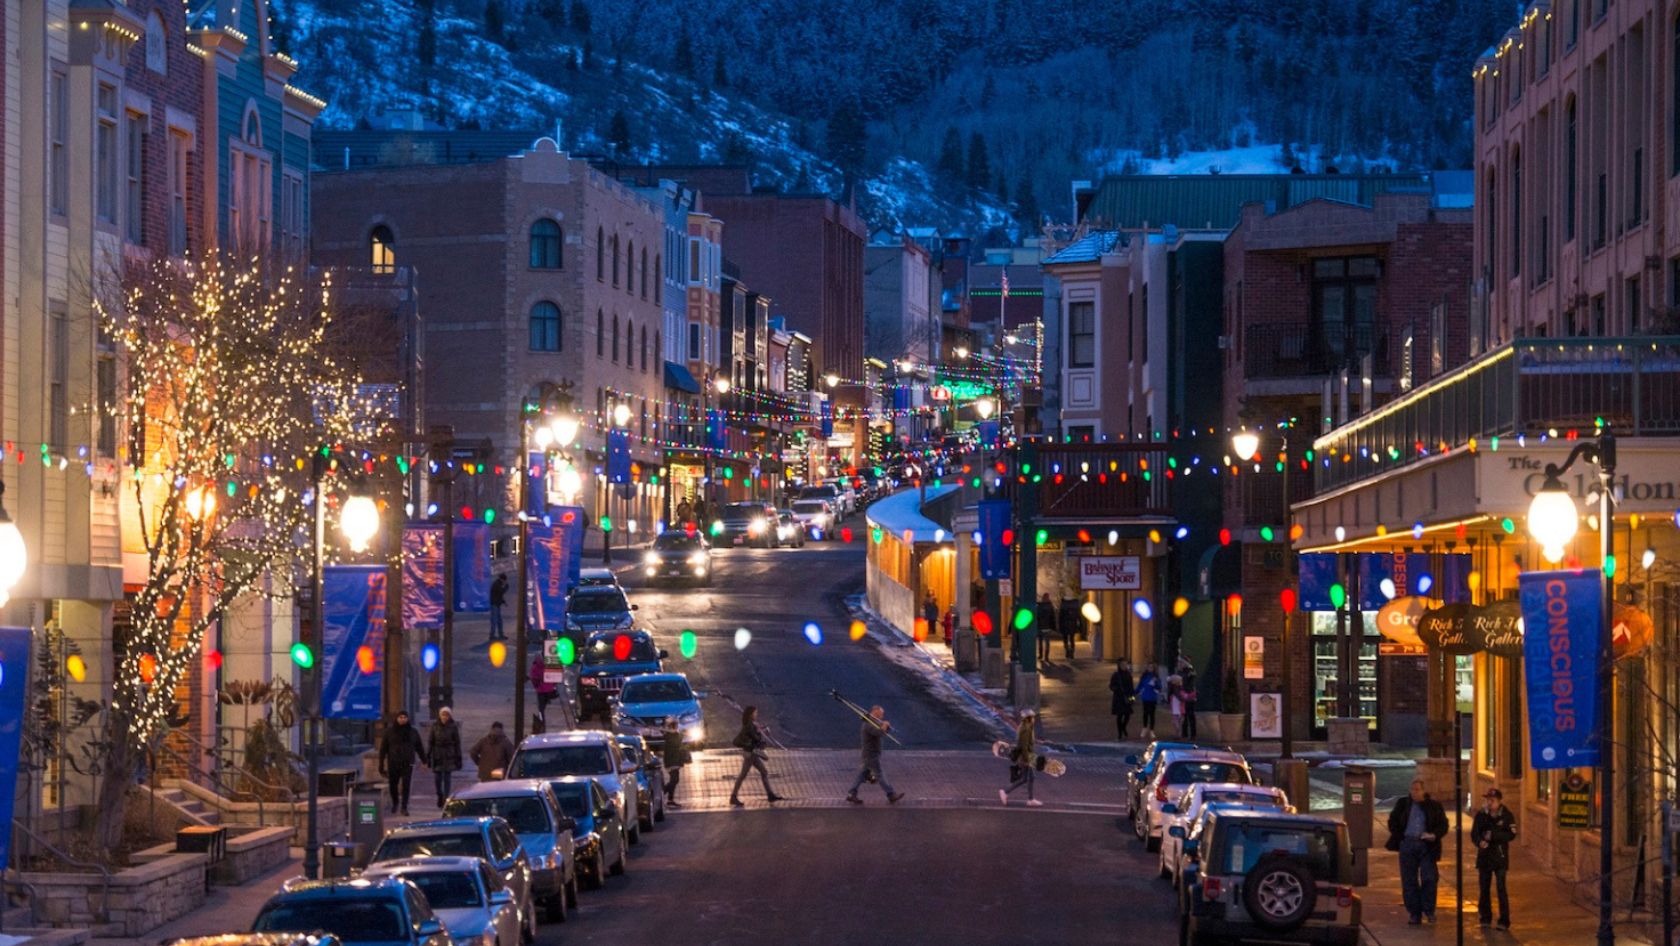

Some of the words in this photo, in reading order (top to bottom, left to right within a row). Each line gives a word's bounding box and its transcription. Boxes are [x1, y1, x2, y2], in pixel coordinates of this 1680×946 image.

[1508, 455, 1542, 470] The
[1523, 473, 1680, 501] Cledon
[1545, 579, 1575, 732] CONSCIOUS
